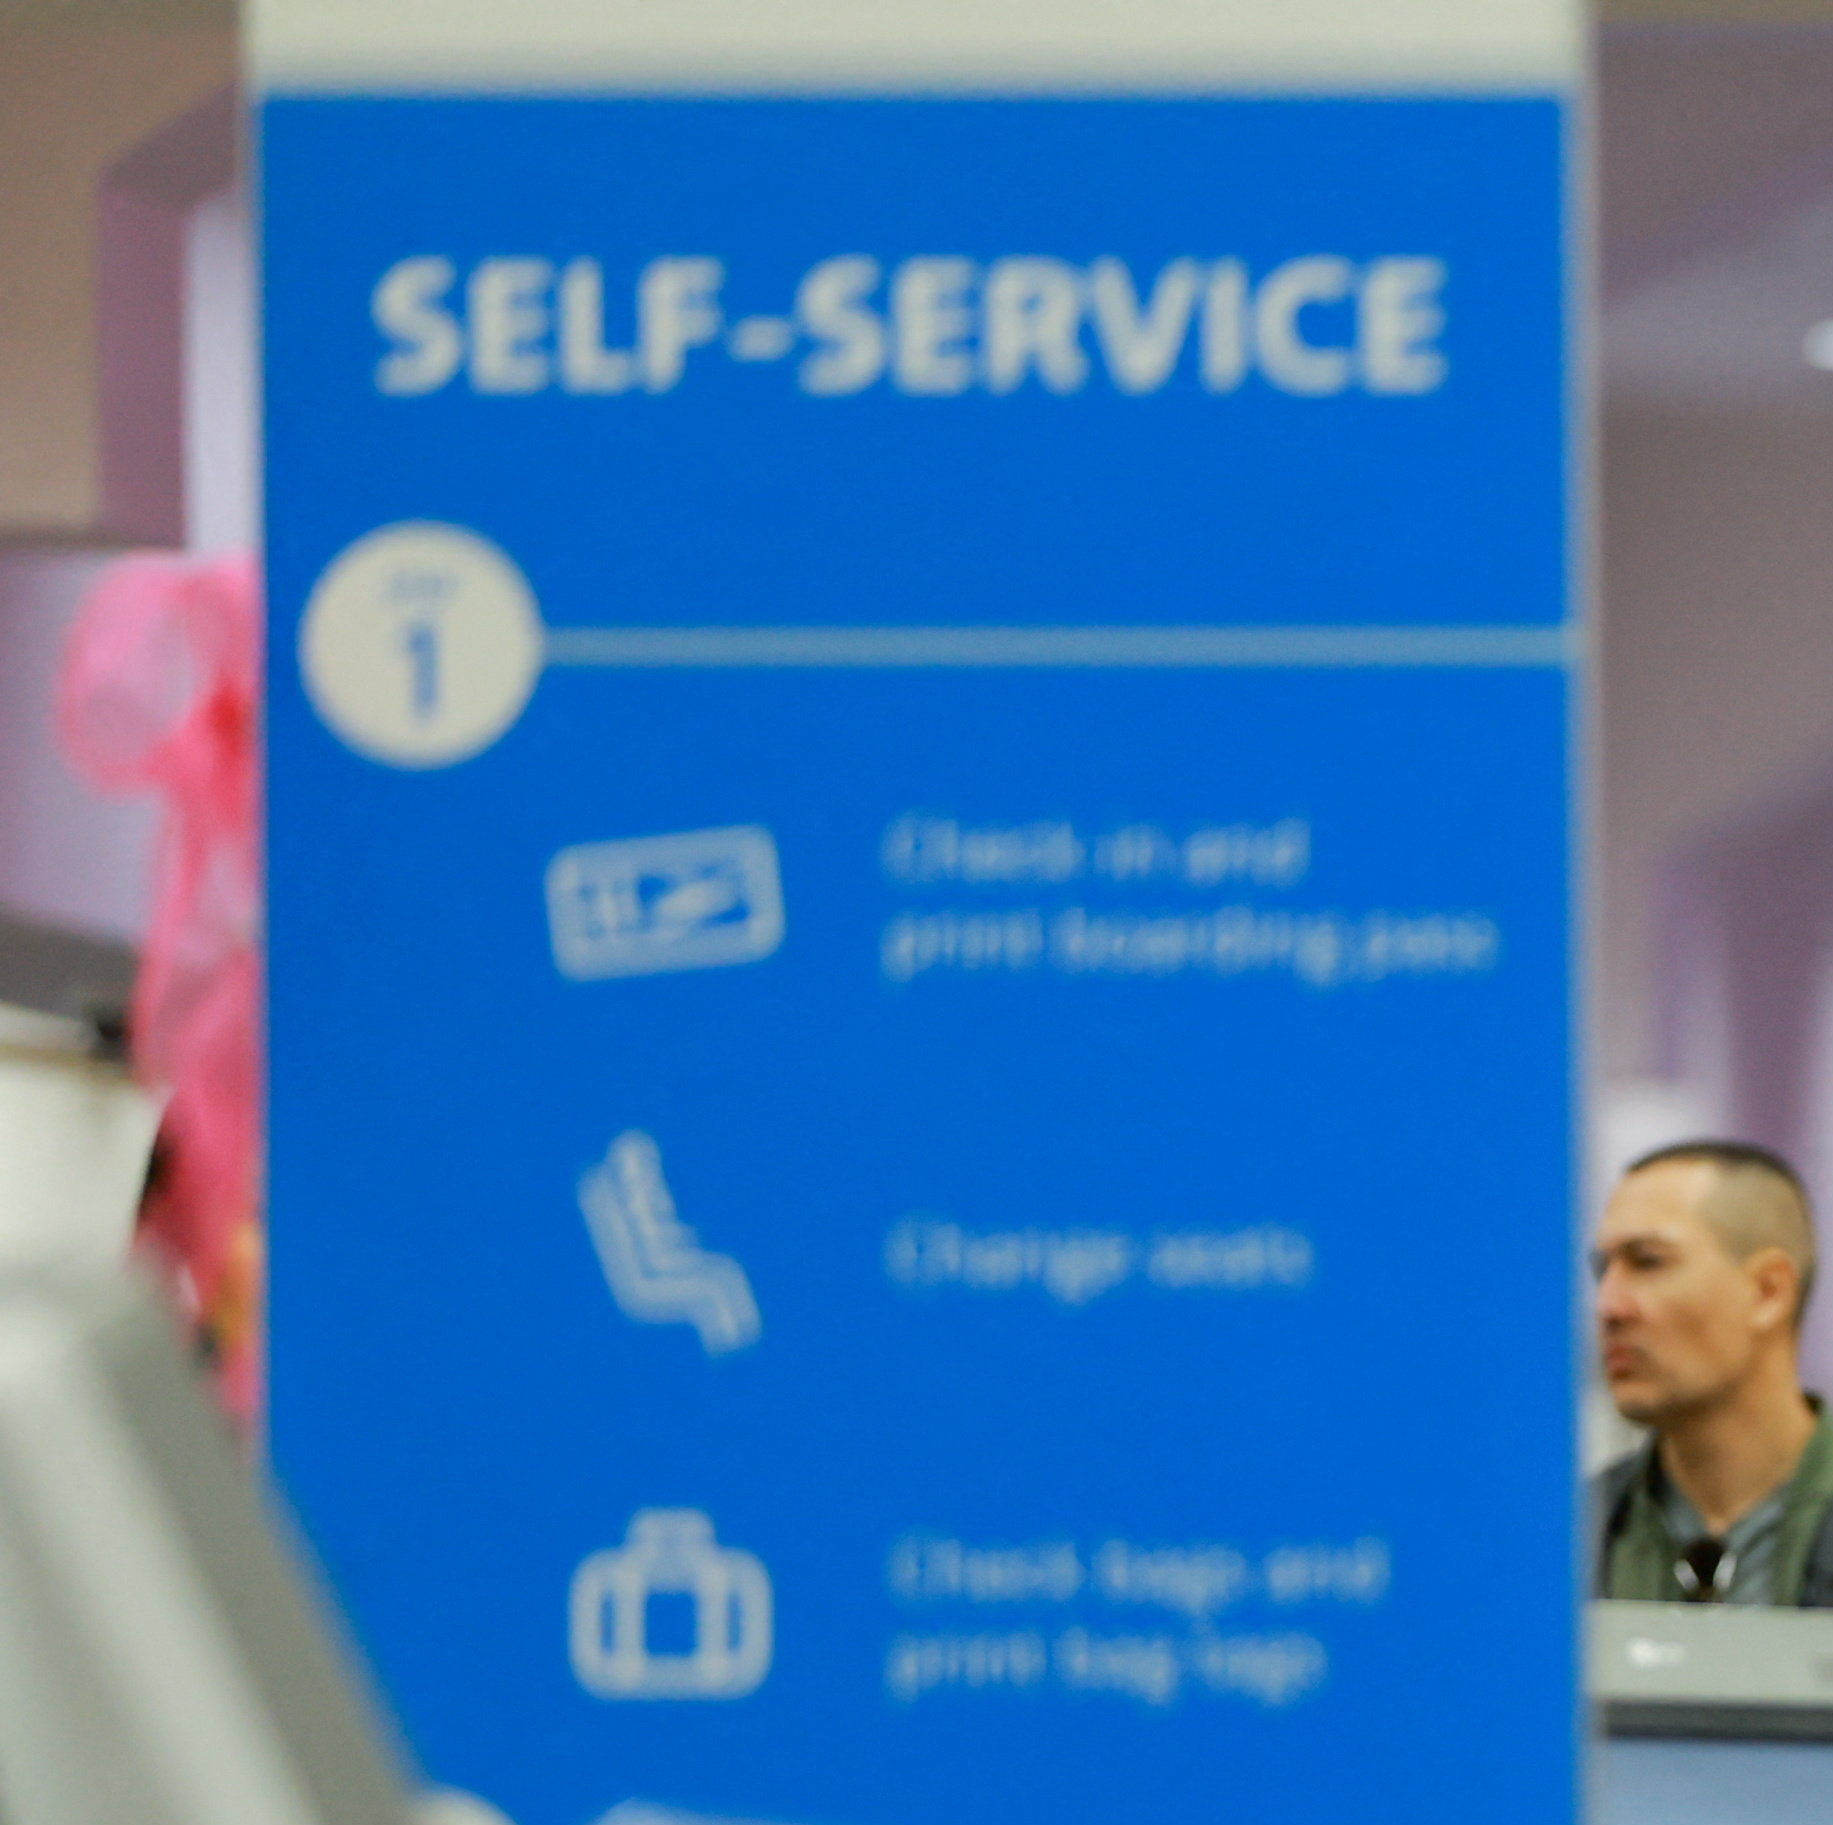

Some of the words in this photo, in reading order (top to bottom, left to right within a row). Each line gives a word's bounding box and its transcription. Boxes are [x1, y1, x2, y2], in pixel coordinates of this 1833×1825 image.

[372, 255, 1446, 396] SELF-SERVICE
[404, 618, 440, 726] 1
[884, 817, 1077, 883] Check
[1185, 819, 1311, 884] and
[882, 908, 1043, 980] print
[1050, 906, 1342, 986] boarding
[887, 1220, 1132, 1304] Change
[1147, 1226, 1312, 1289] seats
[888, 1538, 1077, 1602] Check
[1095, 1538, 1246, 1616] bags
[1264, 1538, 1389, 1602] and
[884, 1631, 1045, 1702] print
[1055, 1627, 1180, 1706] bag
